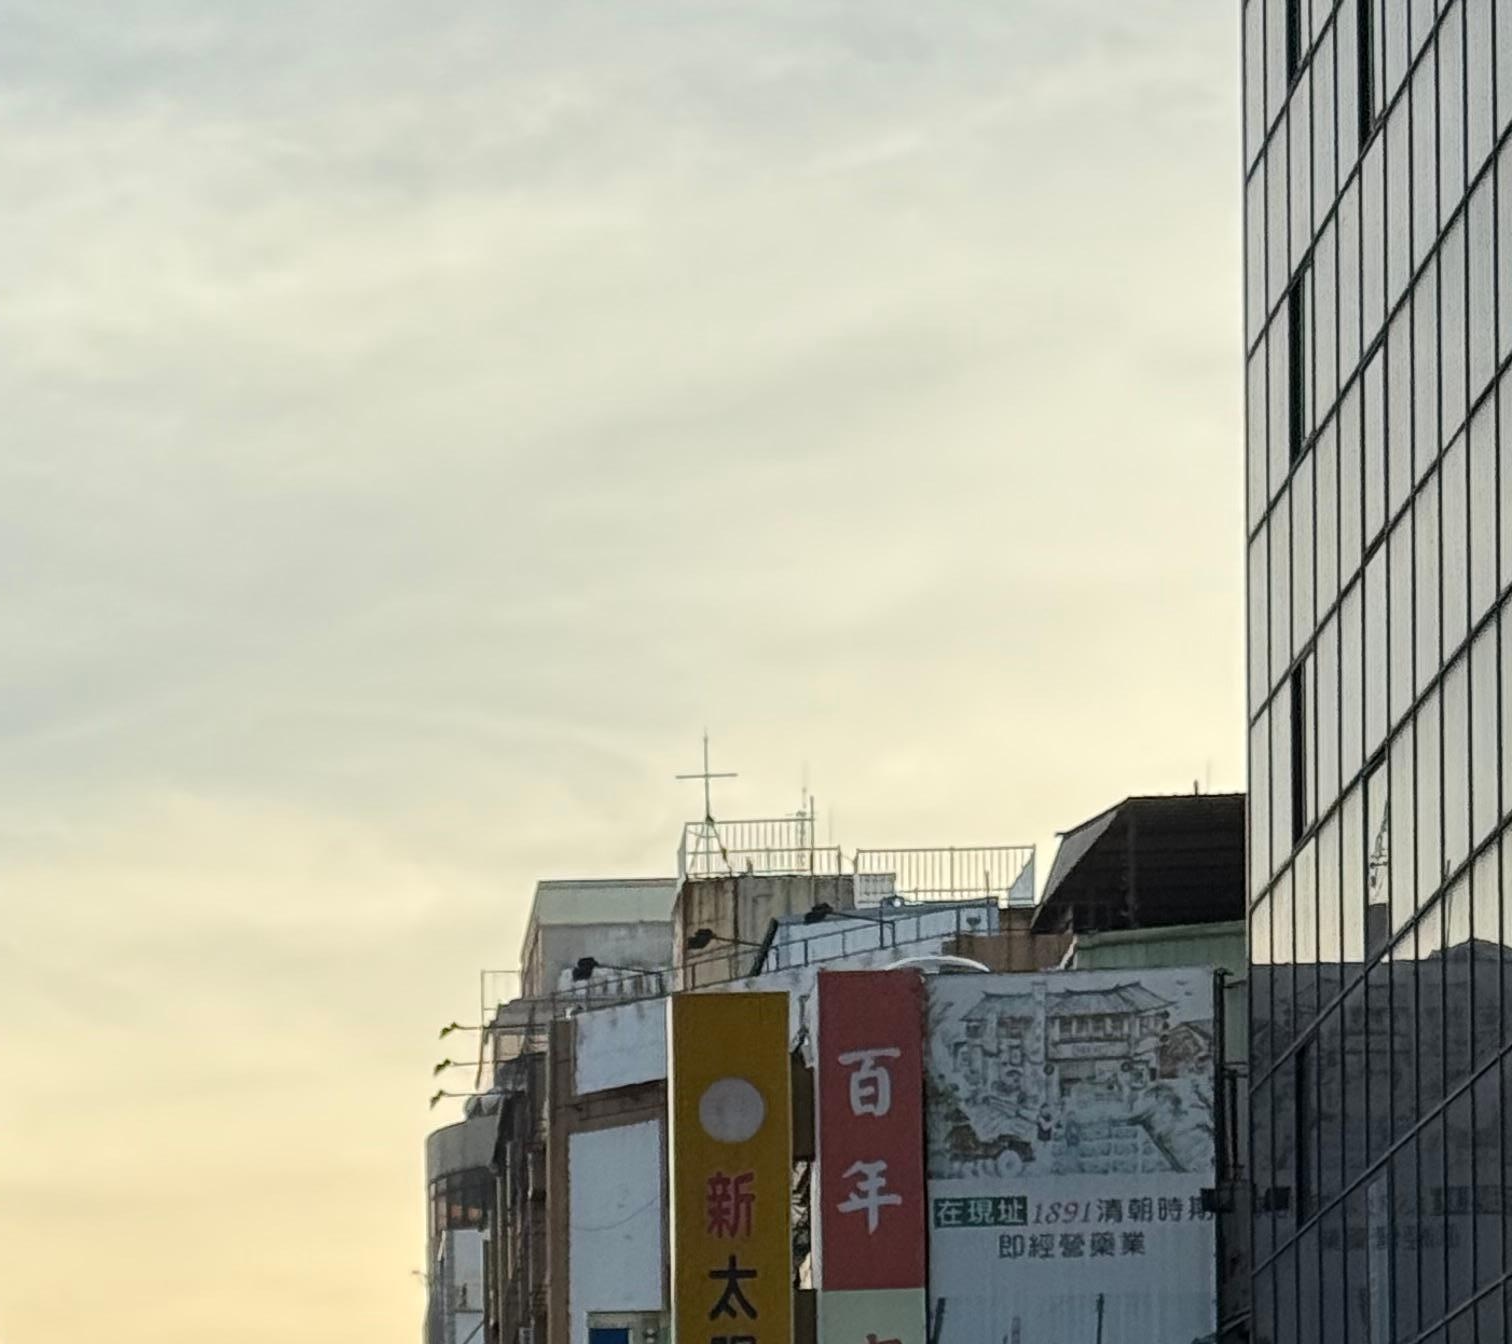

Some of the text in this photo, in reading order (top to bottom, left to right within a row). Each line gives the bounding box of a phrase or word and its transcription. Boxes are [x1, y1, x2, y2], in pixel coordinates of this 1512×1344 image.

[837, 1046, 903, 1236] 百年
[937, 1196, 1026, 1227] 在現址
